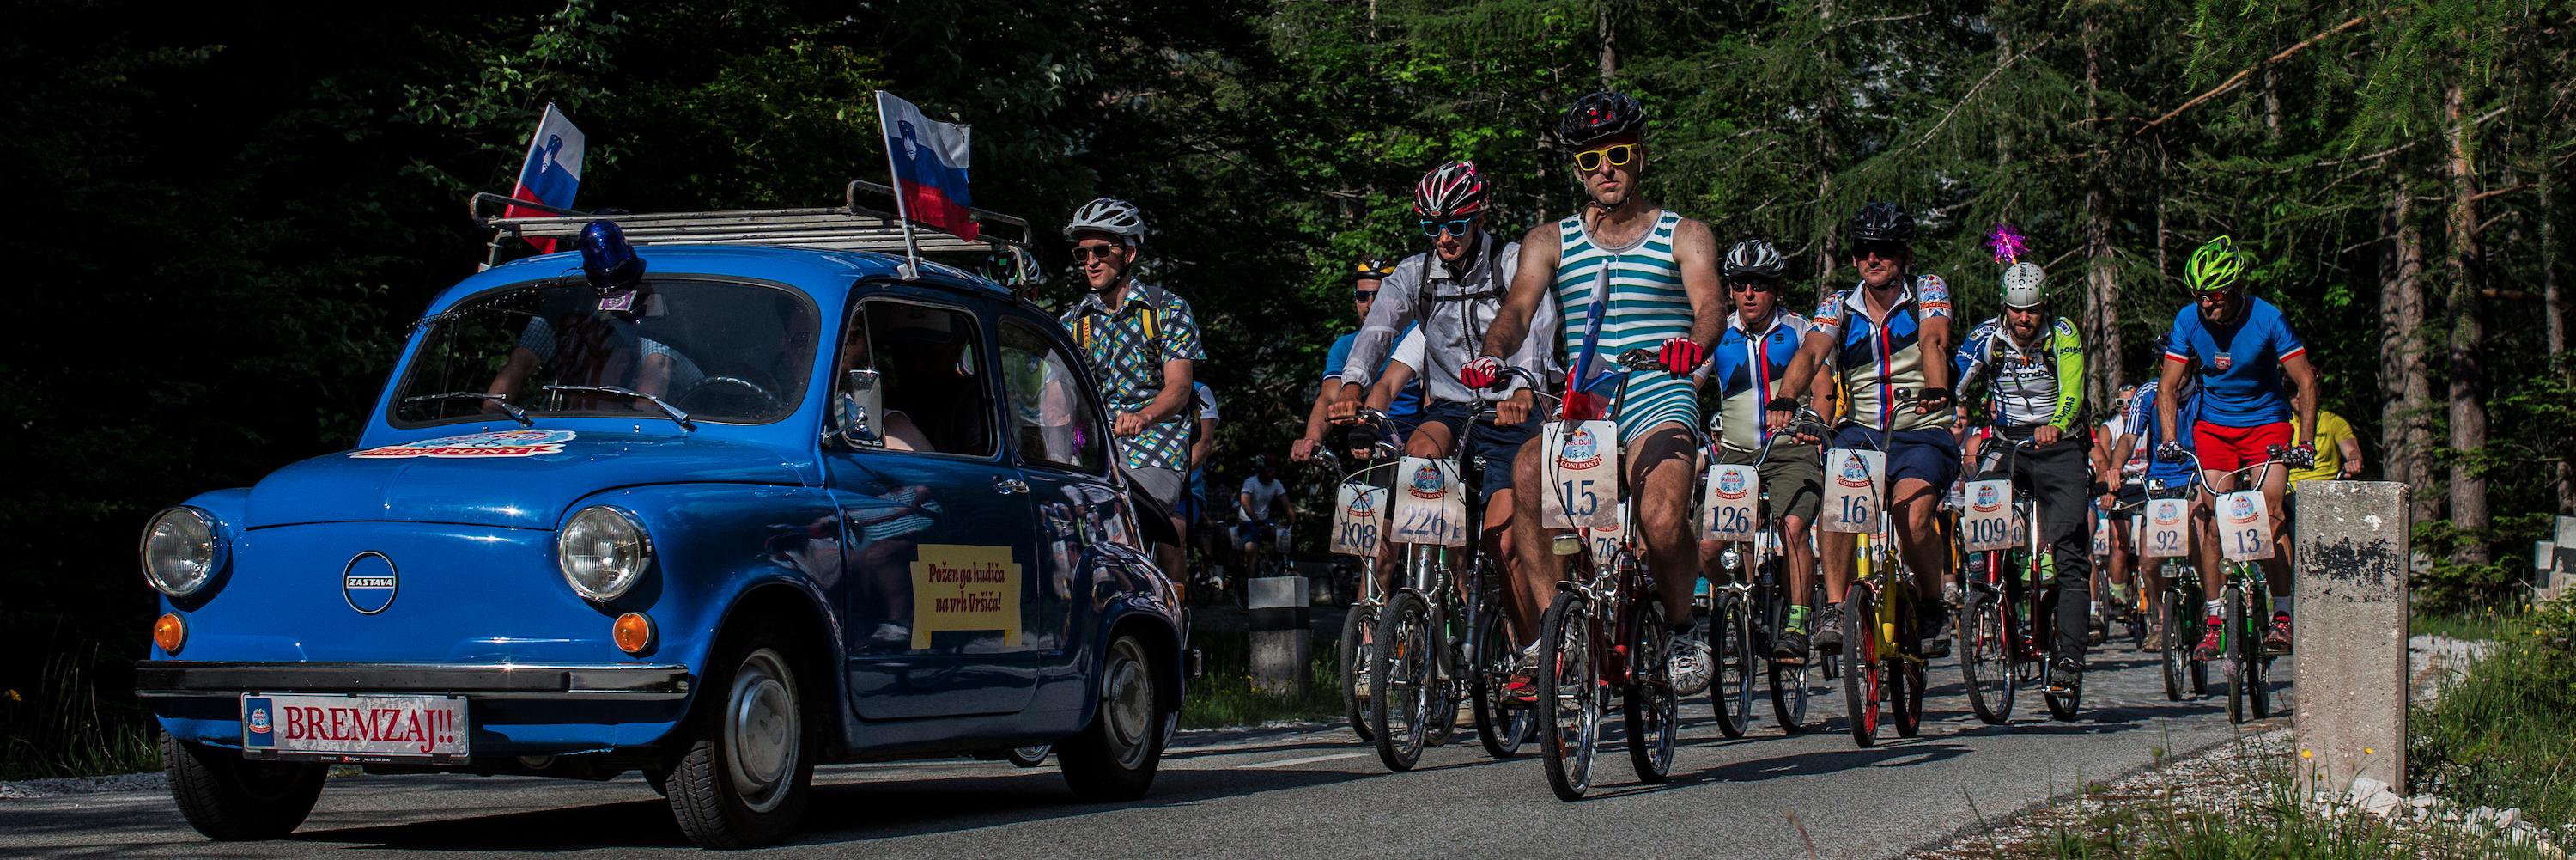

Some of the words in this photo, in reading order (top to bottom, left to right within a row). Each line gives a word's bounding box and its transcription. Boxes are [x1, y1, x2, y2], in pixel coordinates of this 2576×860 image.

[1560, 460, 1578, 469] GONI
[1579, 459, 1598, 469] PONY
[1563, 479, 1598, 516] 15
[1839, 494, 1868, 524] 16
[1399, 504, 1449, 536] 226
[1710, 505, 1750, 534] 126
[1971, 517, 2006, 543] 109
[1338, 521, 1376, 549] 108
[1595, 536, 1618, 558] 76
[2156, 530, 2178, 551] 92
[2234, 528, 2260, 554] 13
[928, 561, 959, 583] Požen
[959, 568, 972, 589] ga
[973, 561, 1005, 583] hudiča
[935, 597, 950, 613] na
[950, 590, 967, 613] vrh
[968, 590, 1002, 613] Vršiča!
[283, 706, 453, 754] BREMZAJ!!
